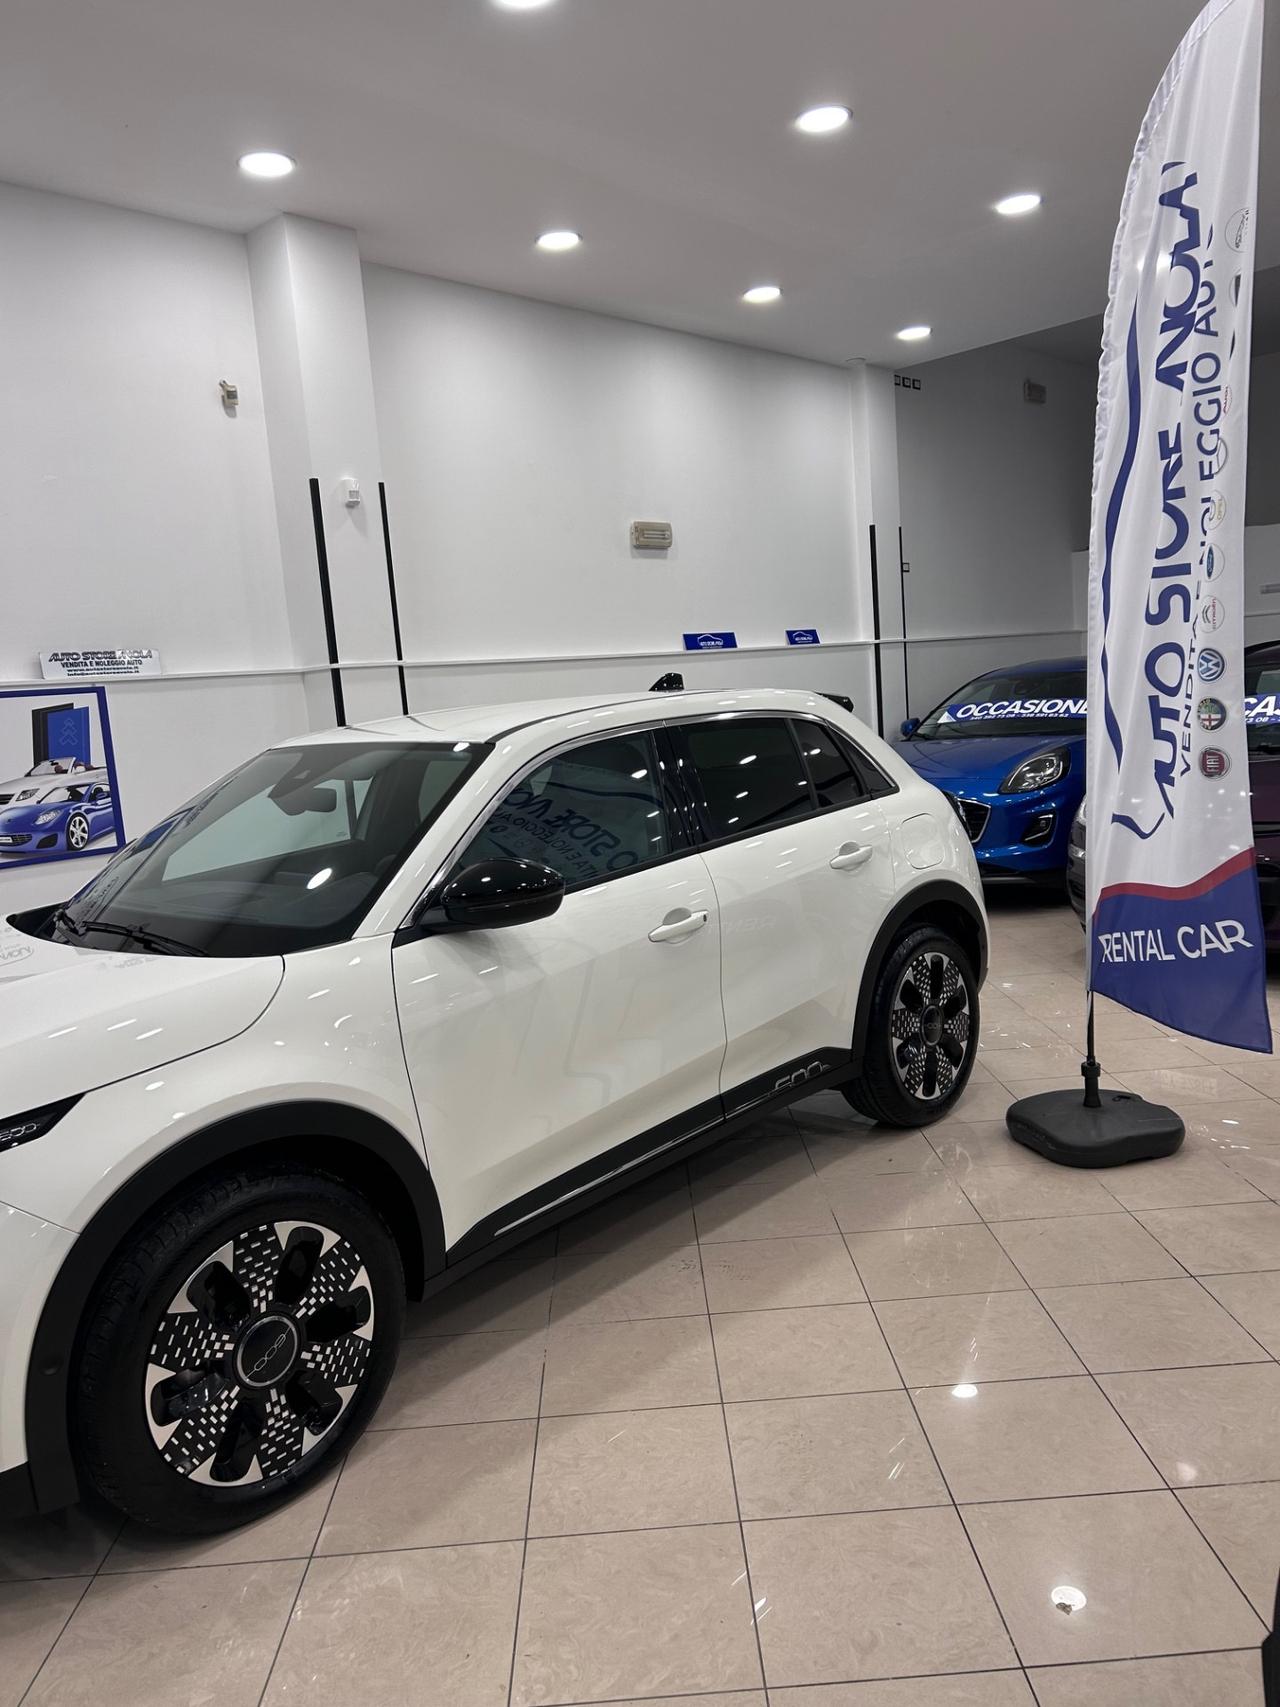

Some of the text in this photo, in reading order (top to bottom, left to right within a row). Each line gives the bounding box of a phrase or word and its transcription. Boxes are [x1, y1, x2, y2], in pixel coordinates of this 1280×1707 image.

[48, 652, 81, 662] AUTO
[82, 651, 116, 661] STORE
[61, 661, 88, 669] VENDITA
[1145, 642, 1185, 819] AUTO
[1206, 754, 1219, 772] FIAT
[1098, 919, 1254, 963] RENTAL CAR
